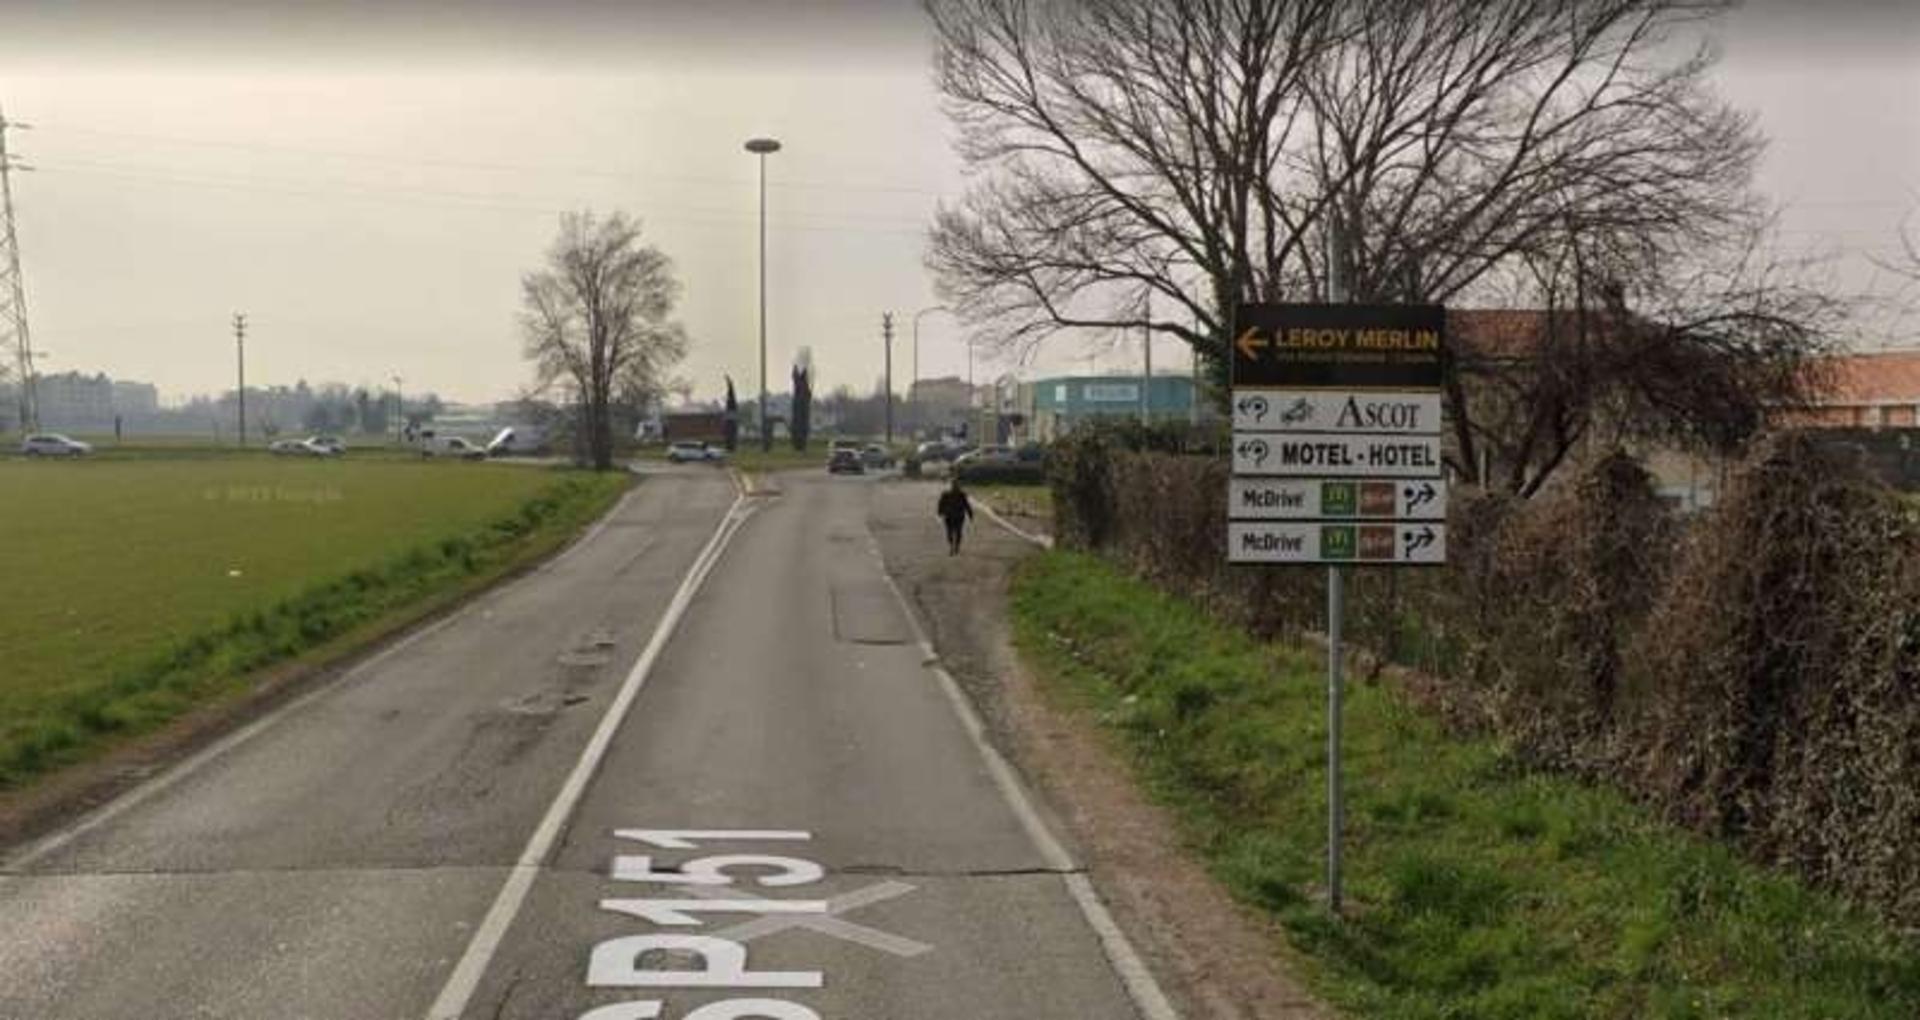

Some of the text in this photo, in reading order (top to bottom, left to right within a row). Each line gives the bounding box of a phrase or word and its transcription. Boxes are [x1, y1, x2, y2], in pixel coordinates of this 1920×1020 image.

[1275, 328, 1439, 349] LEROY MERLIN
[1282, 442, 1352, 466] MOTEL
[1369, 444, 1436, 467] HOTEL
[1243, 489, 1304, 508] McDrive
[1242, 533, 1304, 552] McDrive
